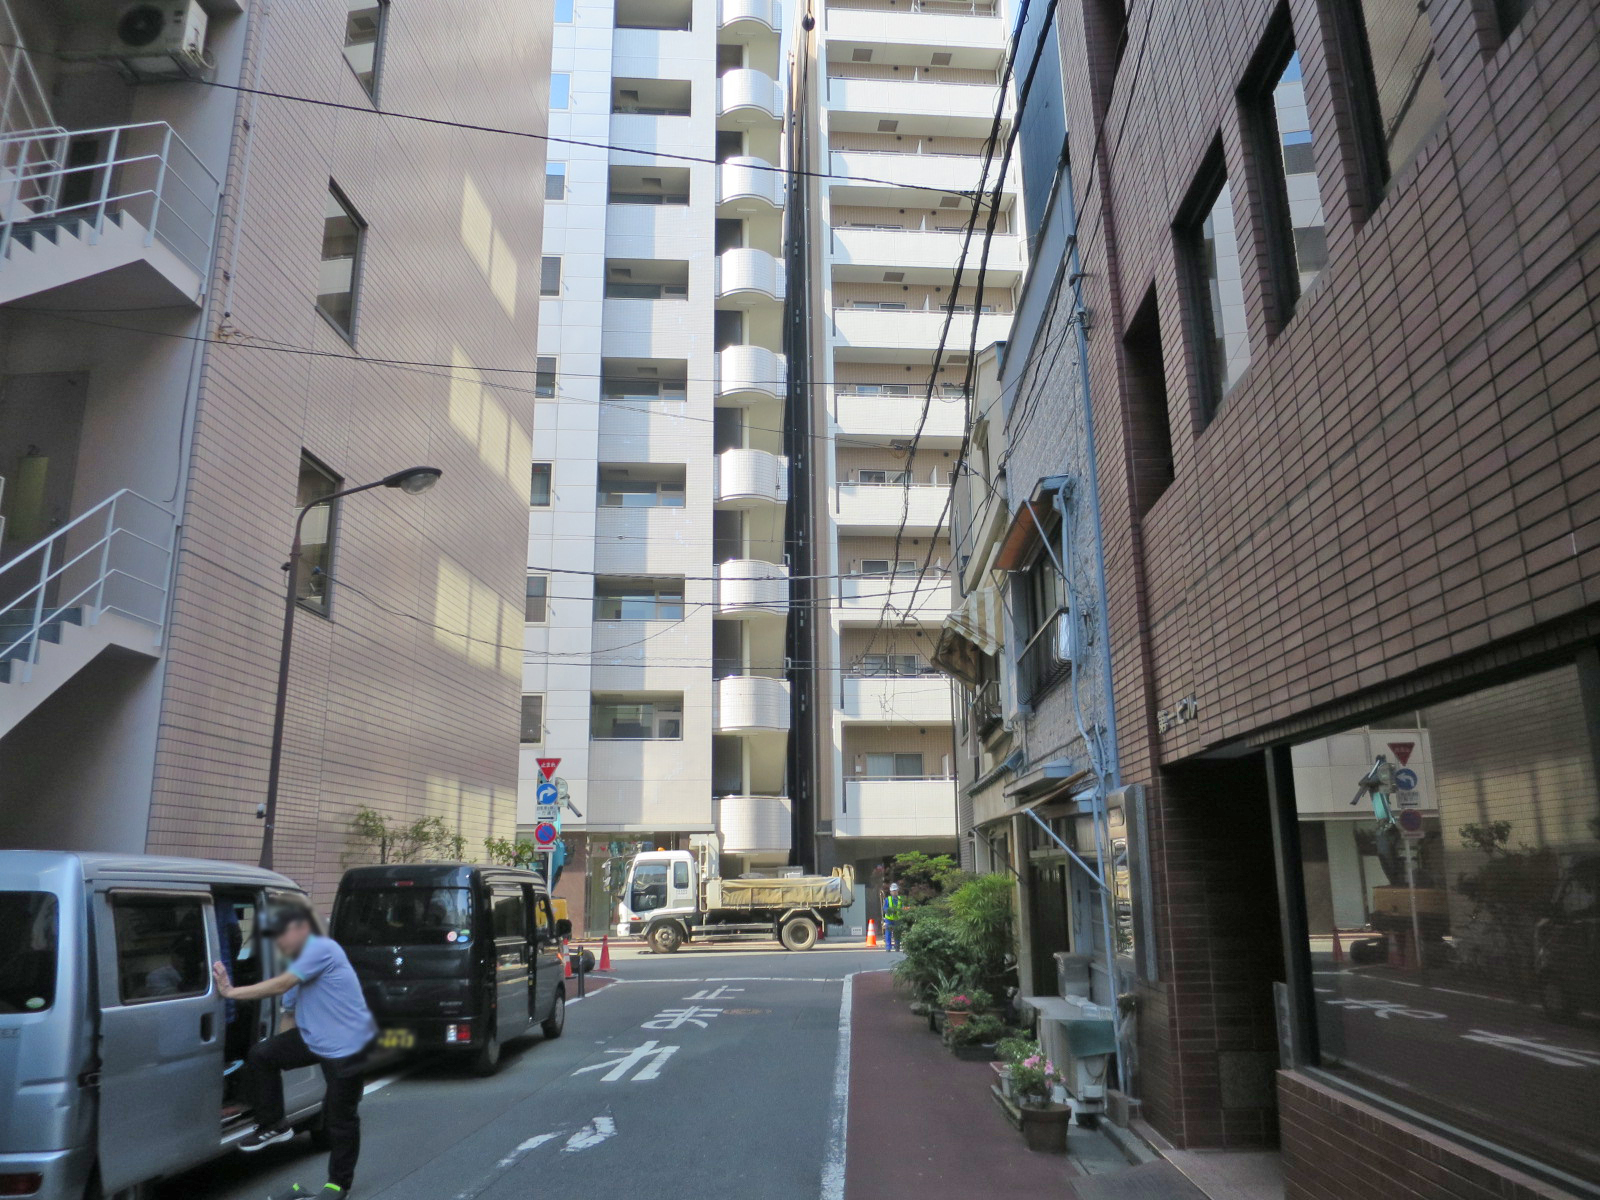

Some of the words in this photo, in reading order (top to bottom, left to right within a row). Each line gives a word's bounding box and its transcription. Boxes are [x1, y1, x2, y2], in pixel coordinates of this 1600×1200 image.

[1157, 694, 1197, 734] 第一ビル
[570, 985, 745, 1082] 止まれ
